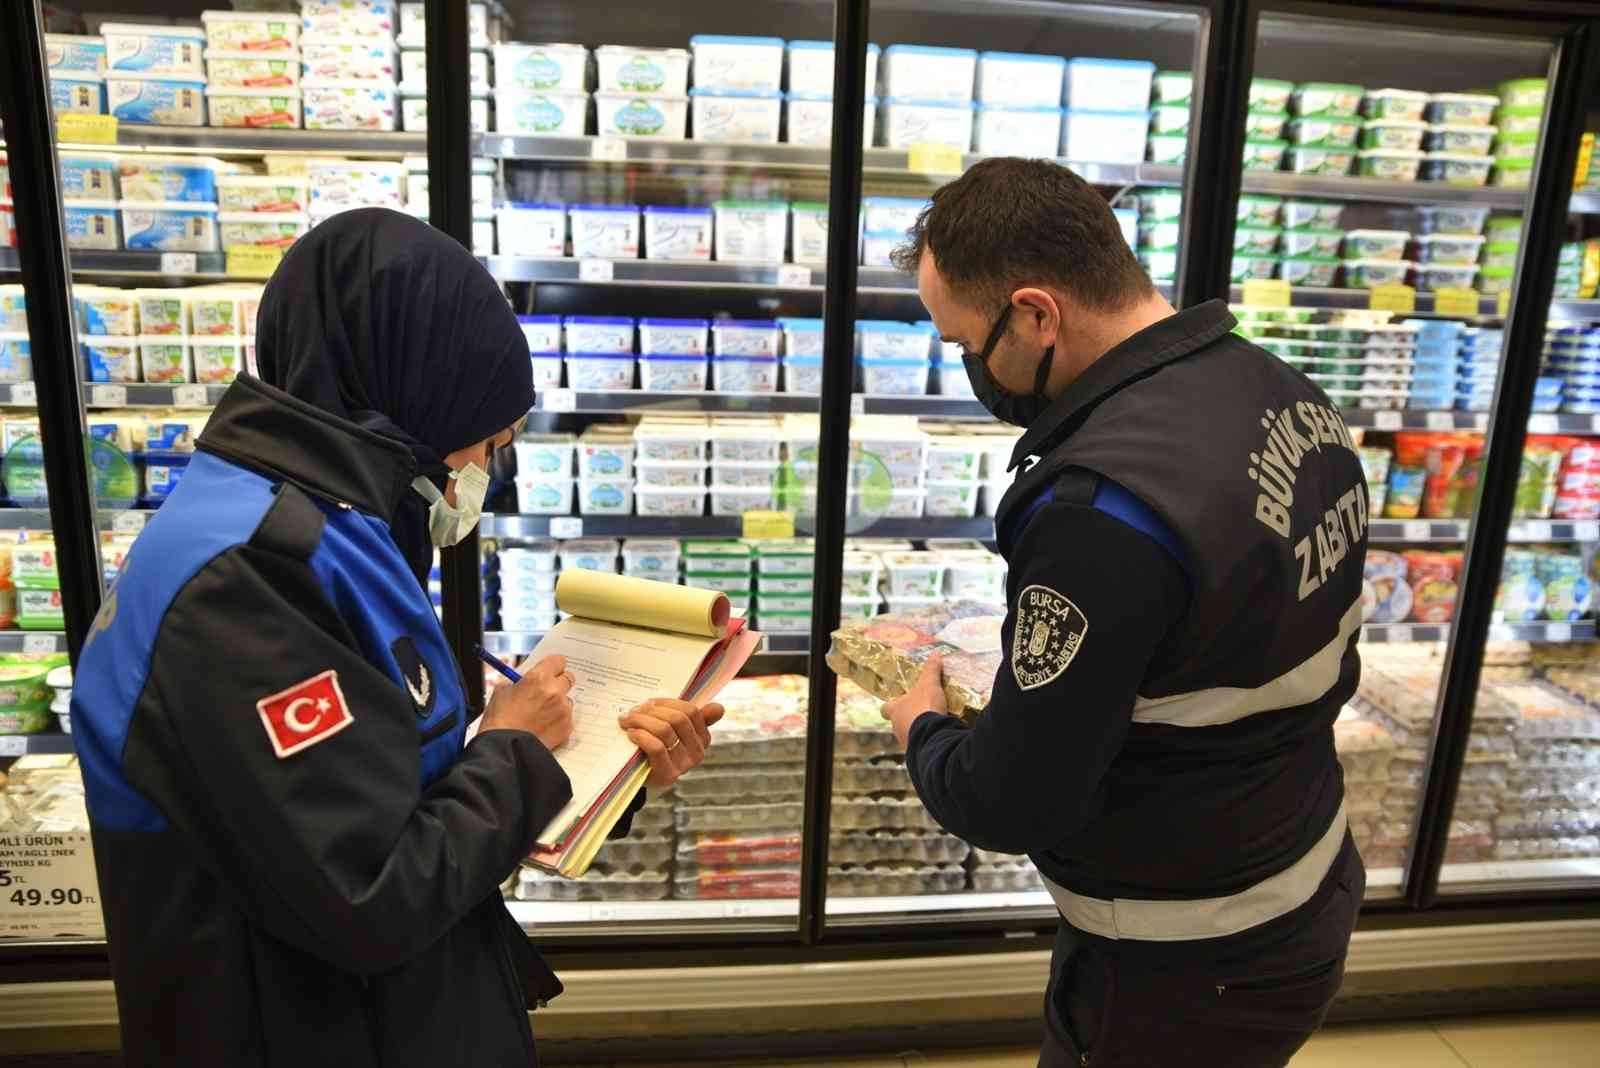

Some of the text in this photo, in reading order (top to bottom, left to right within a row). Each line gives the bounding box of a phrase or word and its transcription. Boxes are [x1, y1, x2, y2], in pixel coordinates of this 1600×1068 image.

[1030, 591, 1070, 621] BURSA
[25, 834, 63, 846] ÜRÜN
[10, 888, 82, 906] 49.90
